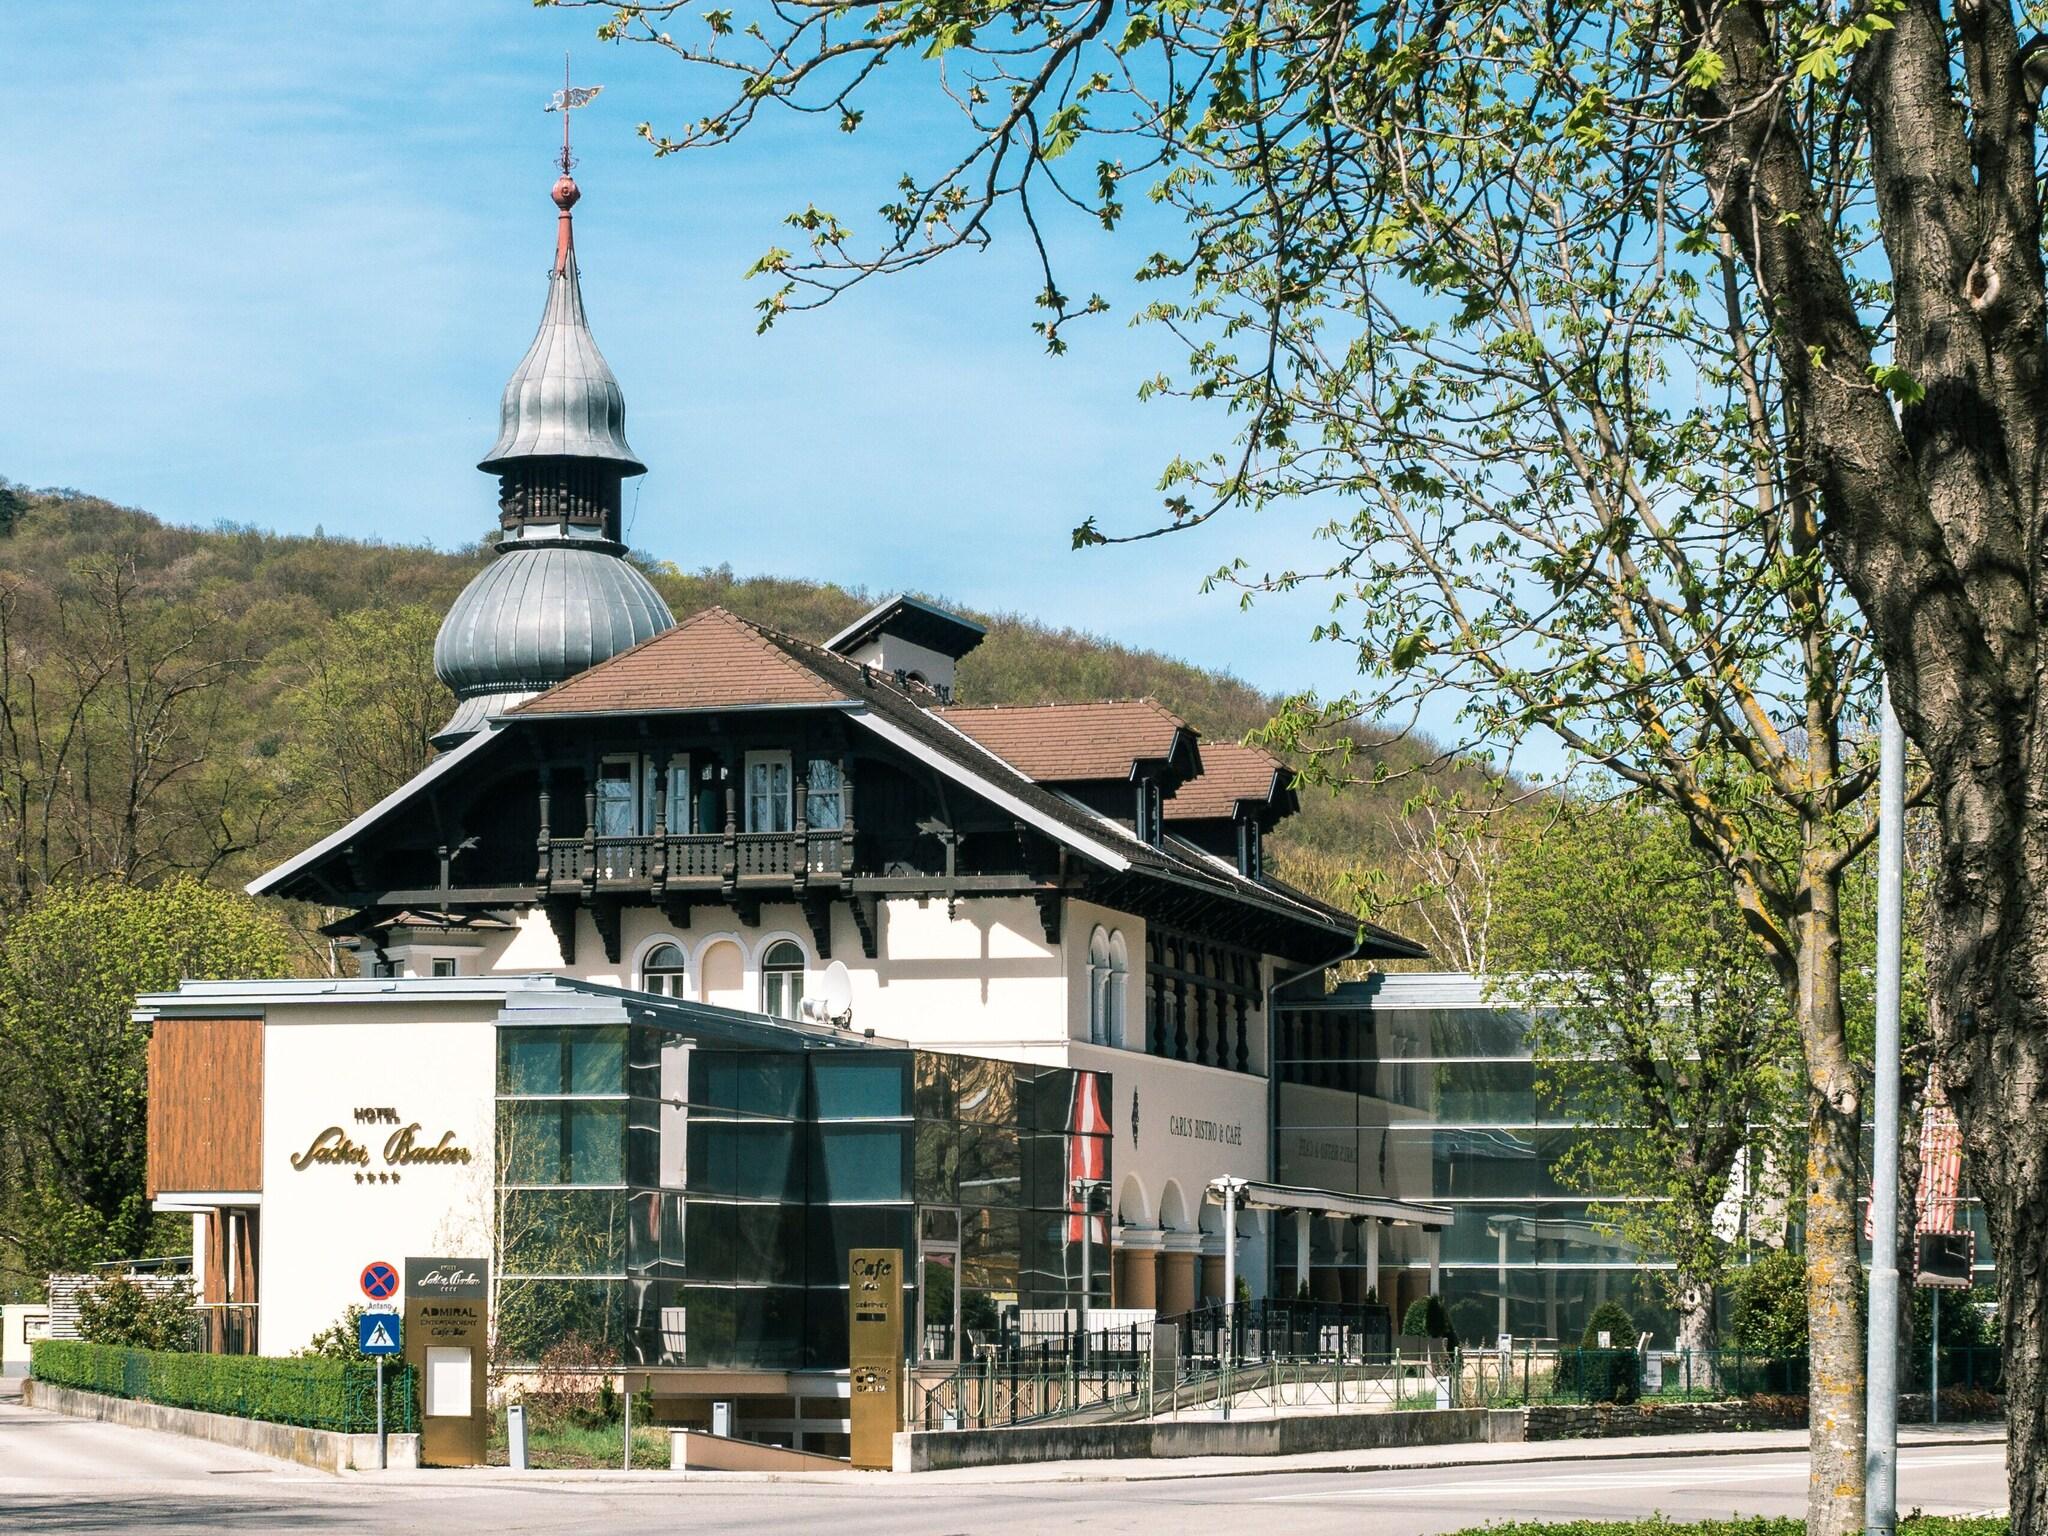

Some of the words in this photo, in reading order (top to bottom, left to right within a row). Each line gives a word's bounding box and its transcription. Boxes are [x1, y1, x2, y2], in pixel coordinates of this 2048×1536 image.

[354, 1107, 399, 1124] HOTEL
[1170, 1115, 1193, 1137] CARL'S
[1195, 1119, 1218, 1142] BISTRO
[1219, 1124, 1224, 1143] &
[1225, 1121, 1242, 1146] CAFÉ
[367, 1302, 393, 1311] Anfang
[420, 1307, 477, 1318] ADMIRAL
